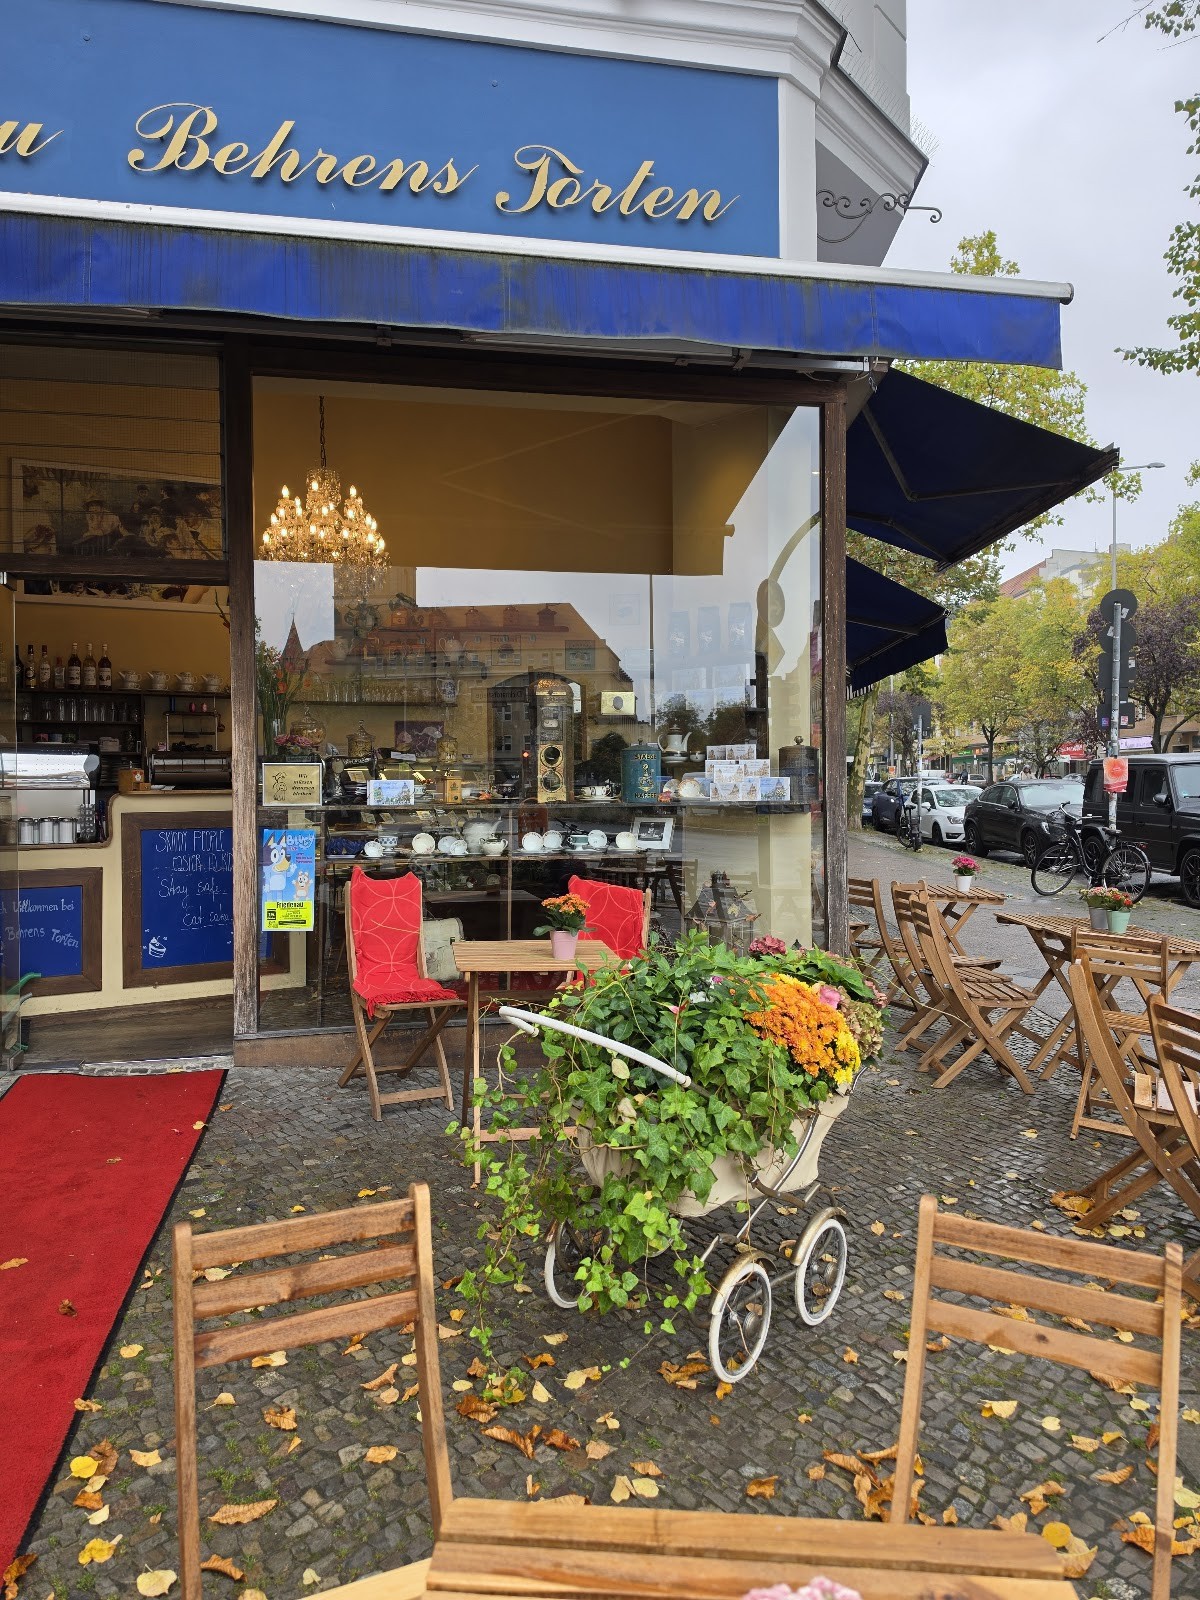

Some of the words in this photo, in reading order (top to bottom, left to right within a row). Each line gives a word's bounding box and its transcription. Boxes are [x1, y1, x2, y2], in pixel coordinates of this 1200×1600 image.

[127, 102, 480, 194] Behrens
[495, 144, 741, 221] Torten
[193, 829, 225, 852] PEOPLE
[60, 898, 75, 911] bei
[5, 926, 46, 941] Behrens
[51, 928, 79, 948] Torten
